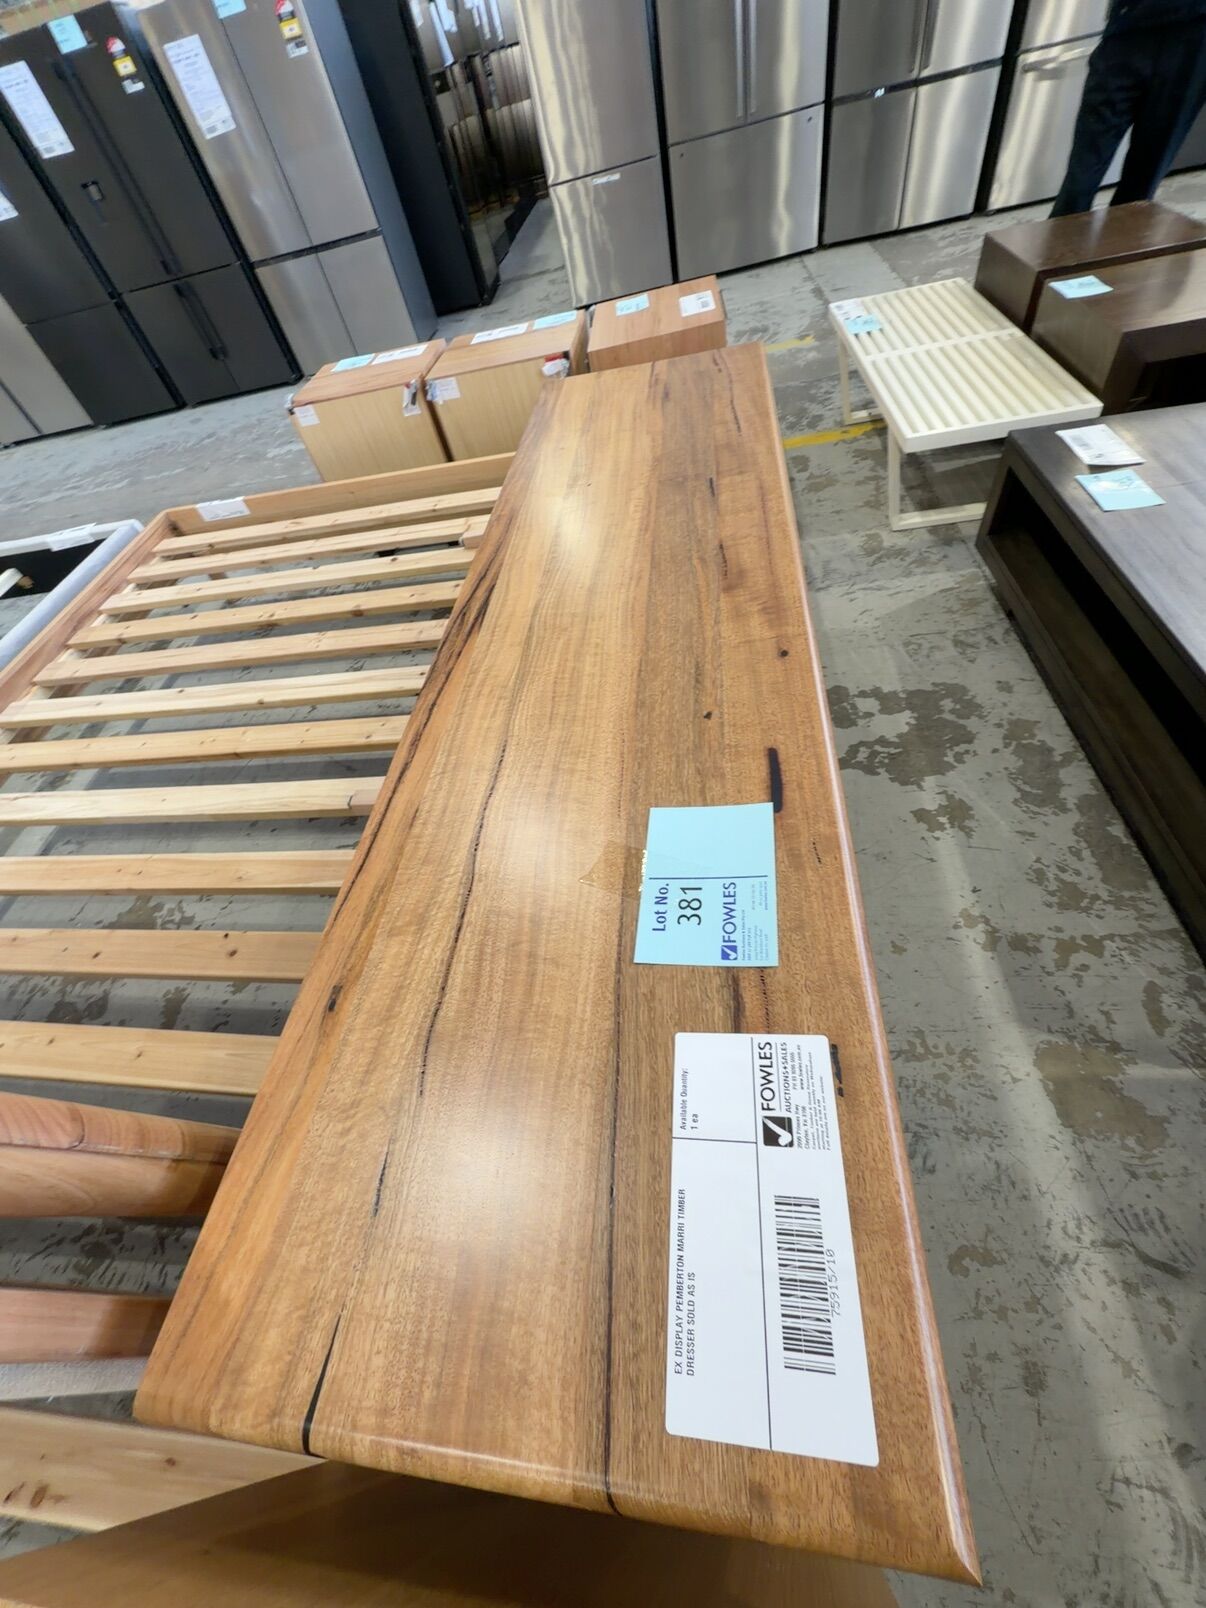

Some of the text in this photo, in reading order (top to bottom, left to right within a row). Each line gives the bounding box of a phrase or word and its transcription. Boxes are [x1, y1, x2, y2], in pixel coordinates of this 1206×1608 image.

[651, 883, 669, 931] Lot No.
[677, 887, 702, 926] 381
[722, 881, 737, 944] FOWLES
[679, 1068, 689, 1131] Available Quantity:
[758, 1041, 776, 1111] FOWLES
[691, 1113, 699, 1123] ea
[674, 1189, 686, 1375] EX DISPLAY PEMBERTON MARRI TIMBER
[825, 1248, 841, 1318] 75915/10
[686, 1272, 696, 1377] DRESSER SOLD AS IS
